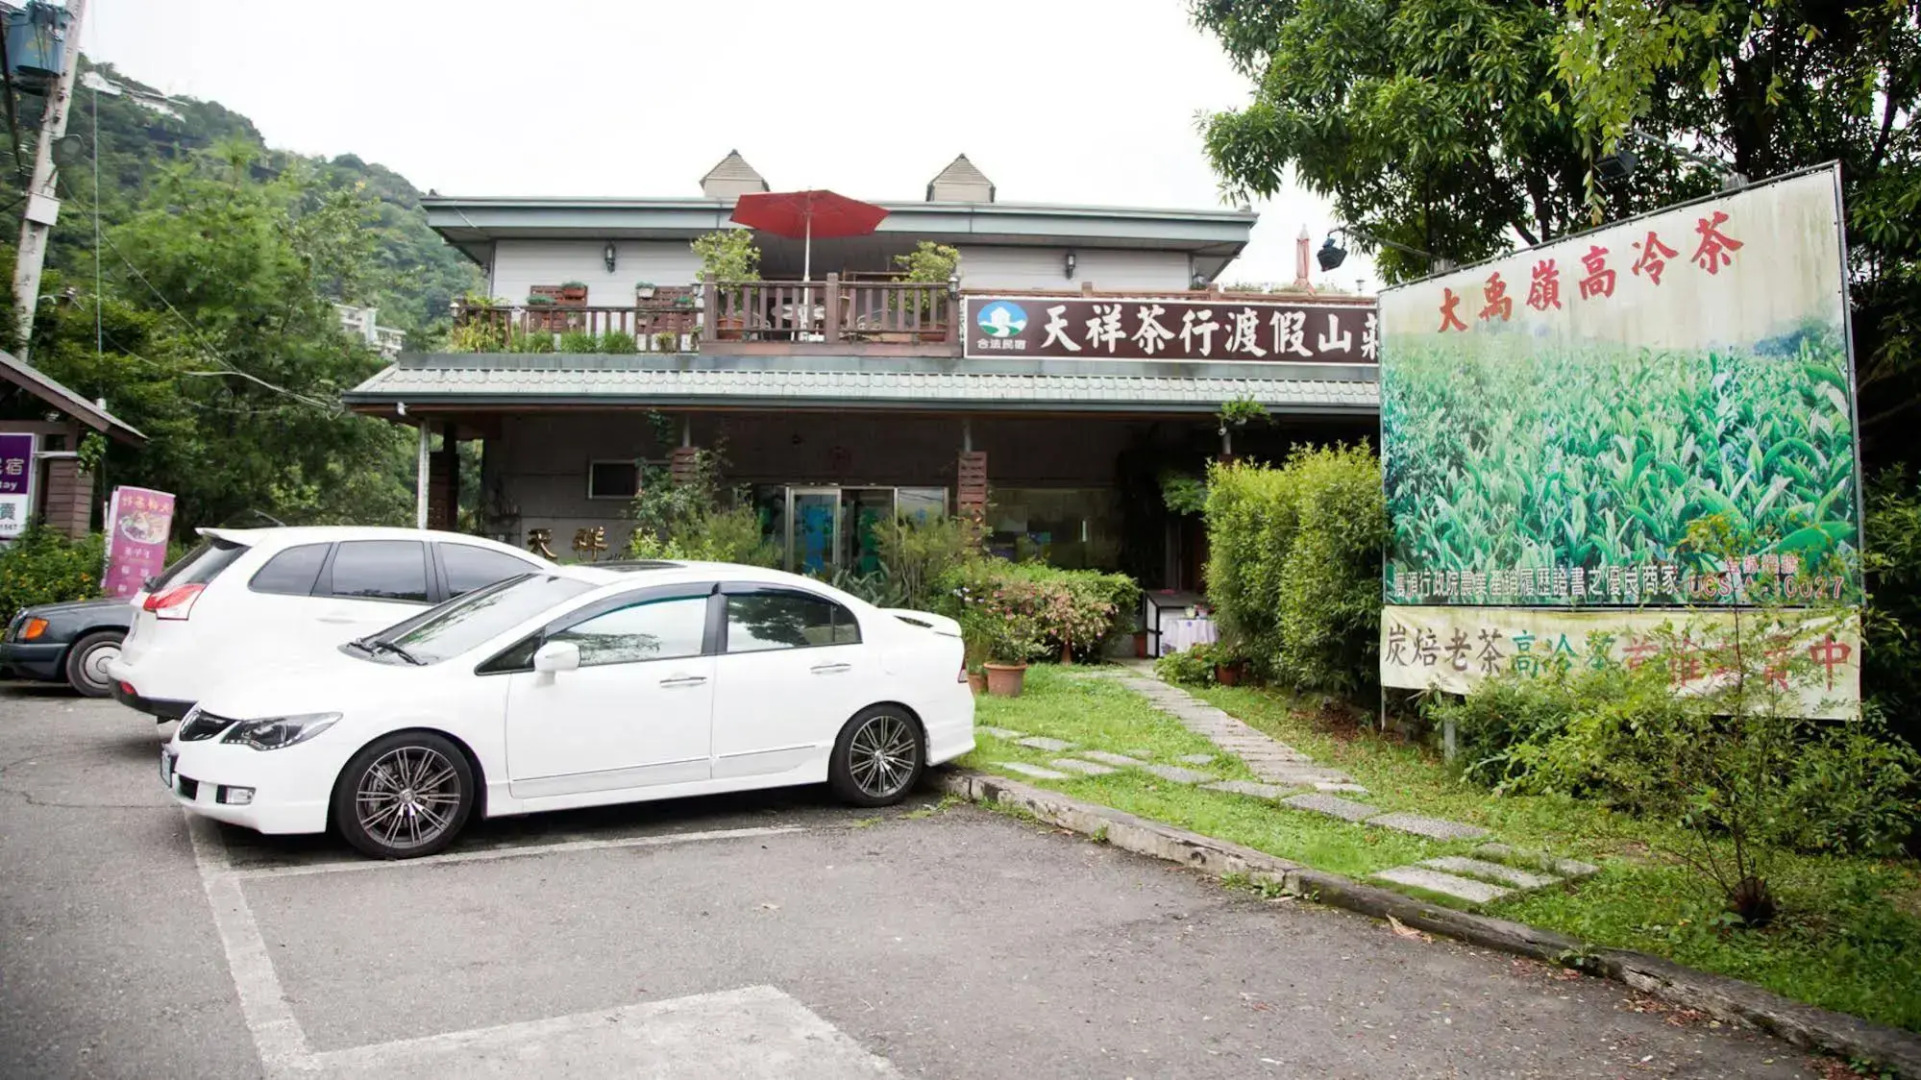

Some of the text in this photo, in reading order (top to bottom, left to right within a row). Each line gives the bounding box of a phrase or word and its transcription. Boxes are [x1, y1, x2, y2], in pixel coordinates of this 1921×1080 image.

[1437, 210, 1745, 334] 大禹嶺高冷茶
[0, 457, 25, 476] 宿
[526, 526, 609, 562] 天祥
